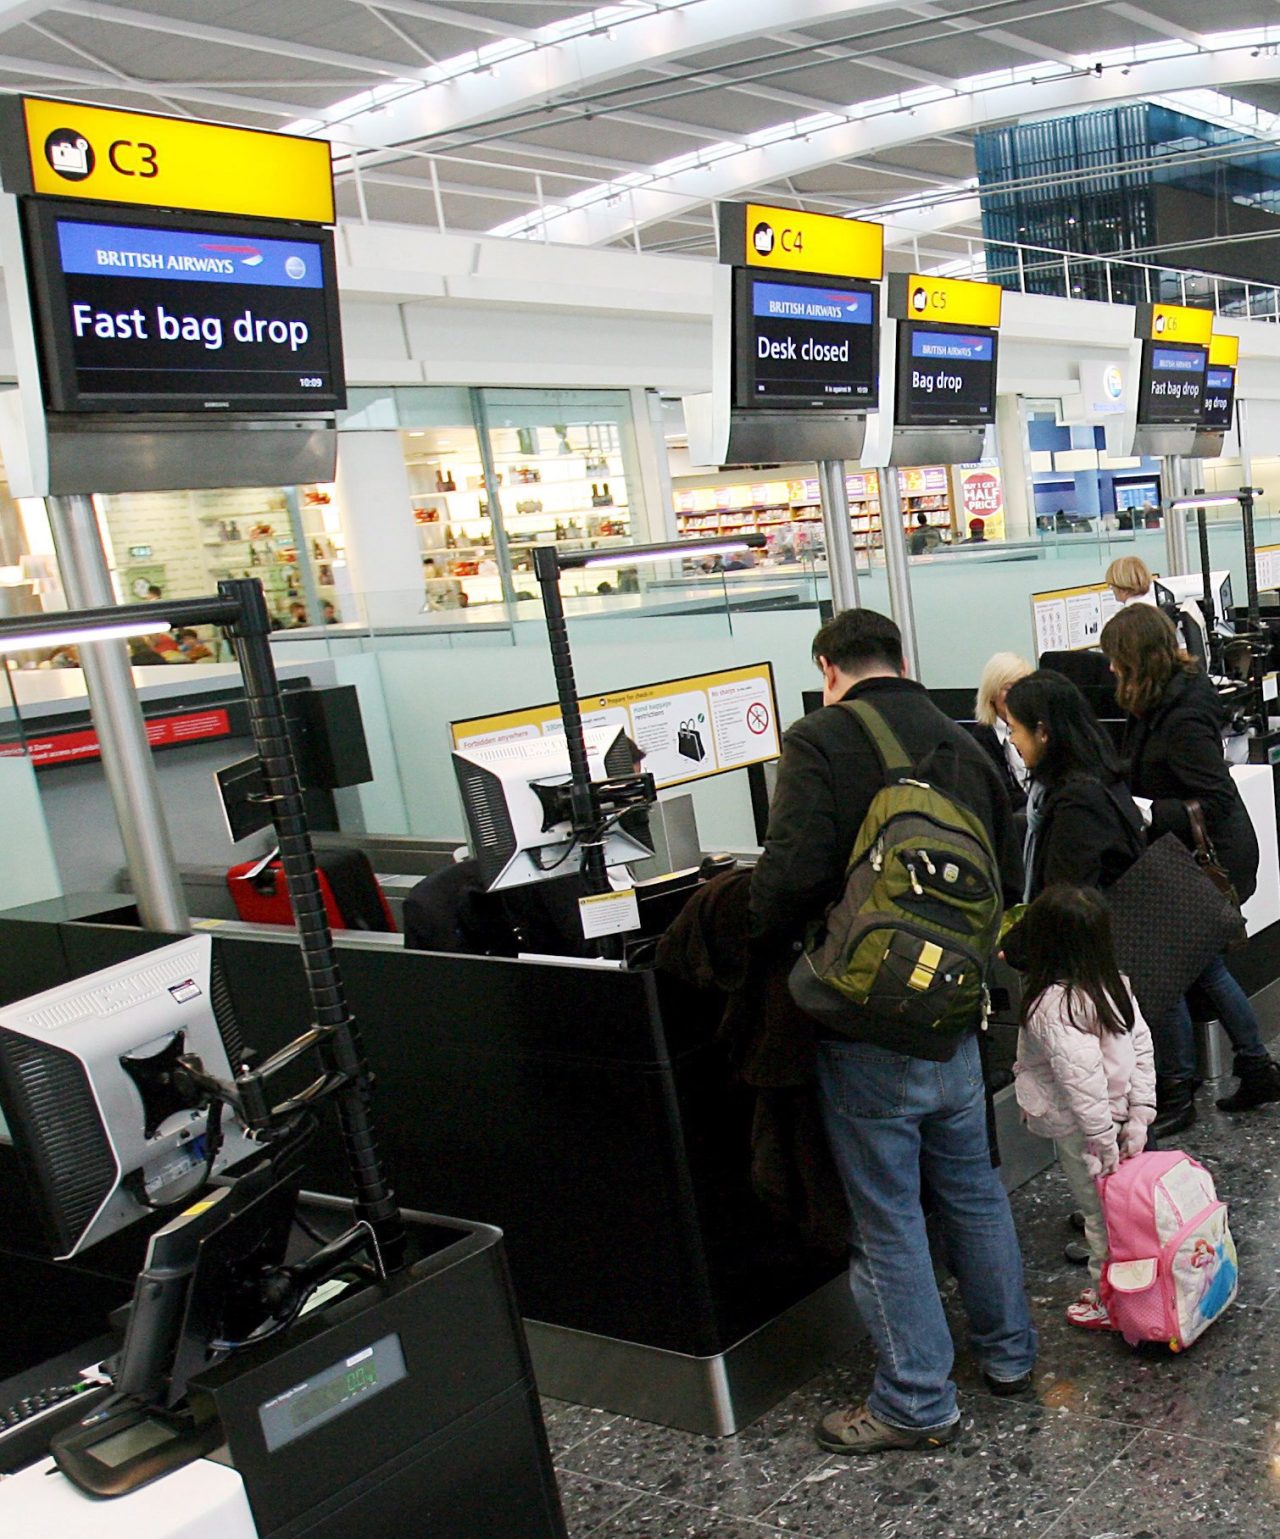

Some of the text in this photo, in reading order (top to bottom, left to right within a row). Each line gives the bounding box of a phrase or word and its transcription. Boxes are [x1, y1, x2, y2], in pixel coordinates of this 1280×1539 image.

[109, 140, 159, 178] C3
[781, 229, 803, 253] C4
[96, 249, 234, 274] BRITISH AIRWAYS
[769, 301, 842, 318] BRITISH AIRWAYS
[931, 292, 947, 309] C5
[73, 304, 309, 351] Fast bag drop
[758, 336, 849, 362] Desk closed
[299, 378, 323, 388] 10:09
[912, 371, 962, 394] Bag drop
[1151, 380, 1166, 395] Fast
[1167, 381, 1181, 398] bag
[1182, 382, 1200, 399] drop
[1213, 396, 1228, 410] drop
[963, 482, 977, 490] BUY
[982, 481, 995, 489] GET
[964, 487, 1000, 502] HALF
[968, 499, 998, 511] PRICE
[464, 731, 528, 749] Forbidden anywhere
